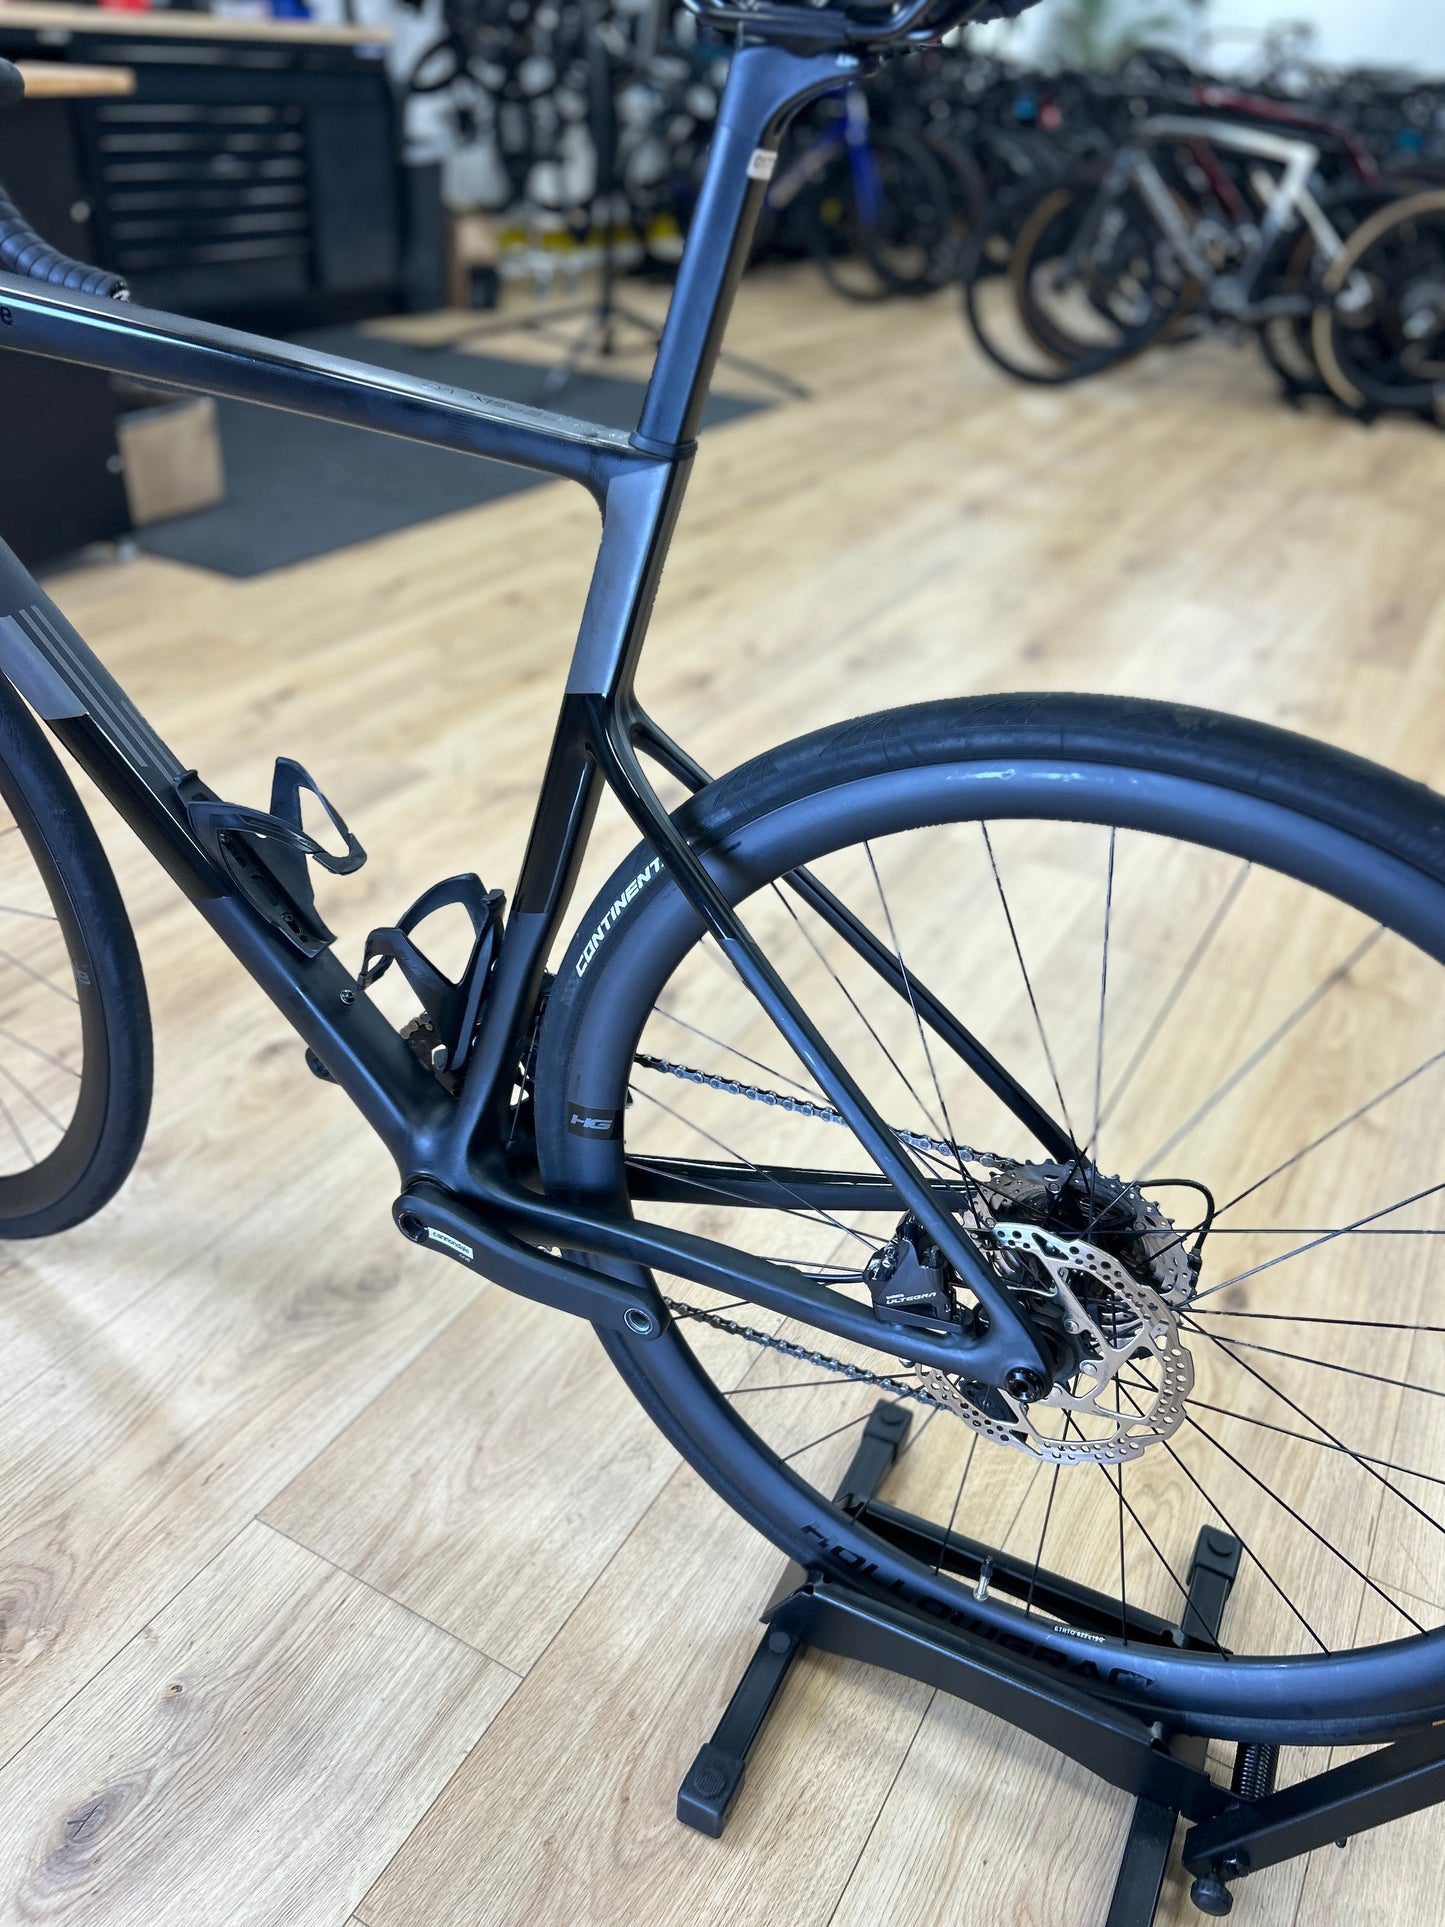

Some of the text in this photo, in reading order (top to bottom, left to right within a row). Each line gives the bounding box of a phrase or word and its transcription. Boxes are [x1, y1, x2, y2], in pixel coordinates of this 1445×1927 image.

[576, 857, 665, 978] CONTINENT
[570, 1113, 613, 1131] HG
[432, 1231, 470, 1254] cannondale
[886, 1291, 937, 1305] ULTEGRA
